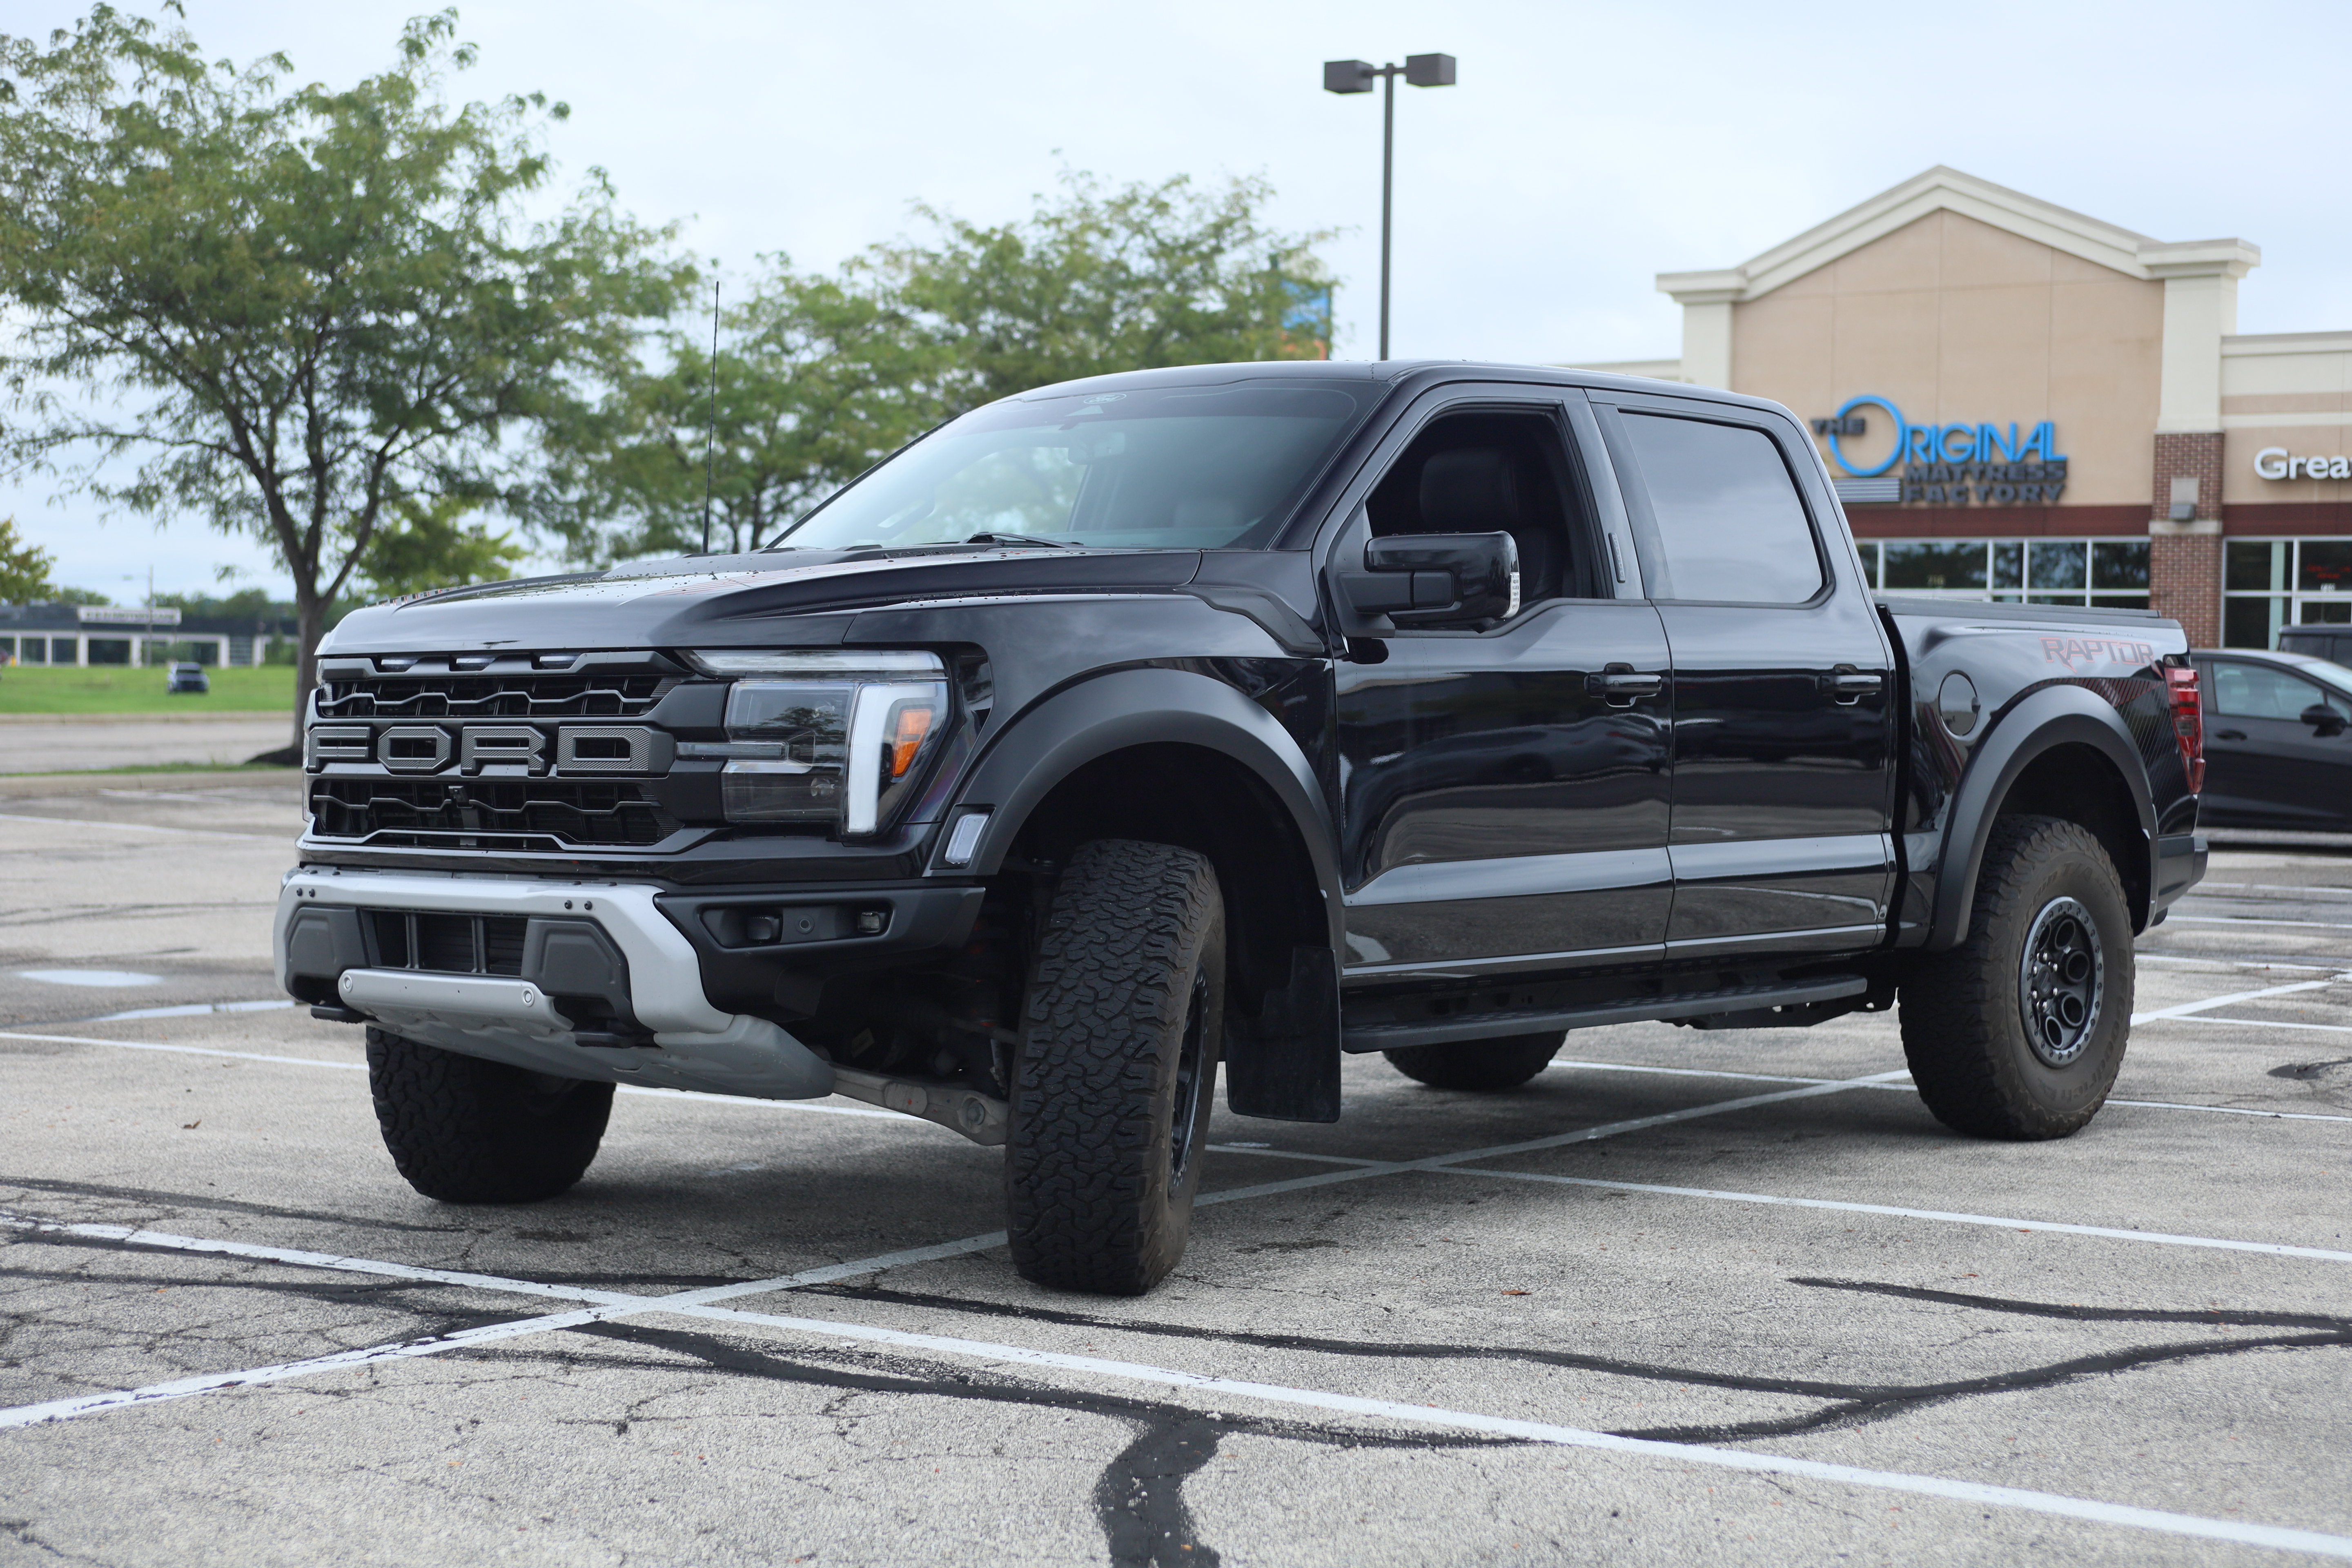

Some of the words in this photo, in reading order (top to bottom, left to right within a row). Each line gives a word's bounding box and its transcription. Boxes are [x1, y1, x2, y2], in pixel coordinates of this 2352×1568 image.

[1811, 418, 1866, 435] THE
[1828, 394, 2067, 477] ORIGINAL
[1904, 464, 2067, 483] MATTRESS
[2254, 447, 2352, 480] Grea
[1902, 484, 2066, 503] FACTORY
[2039, 637, 2163, 679] RAPTOR
[307, 726, 655, 775] FORD
